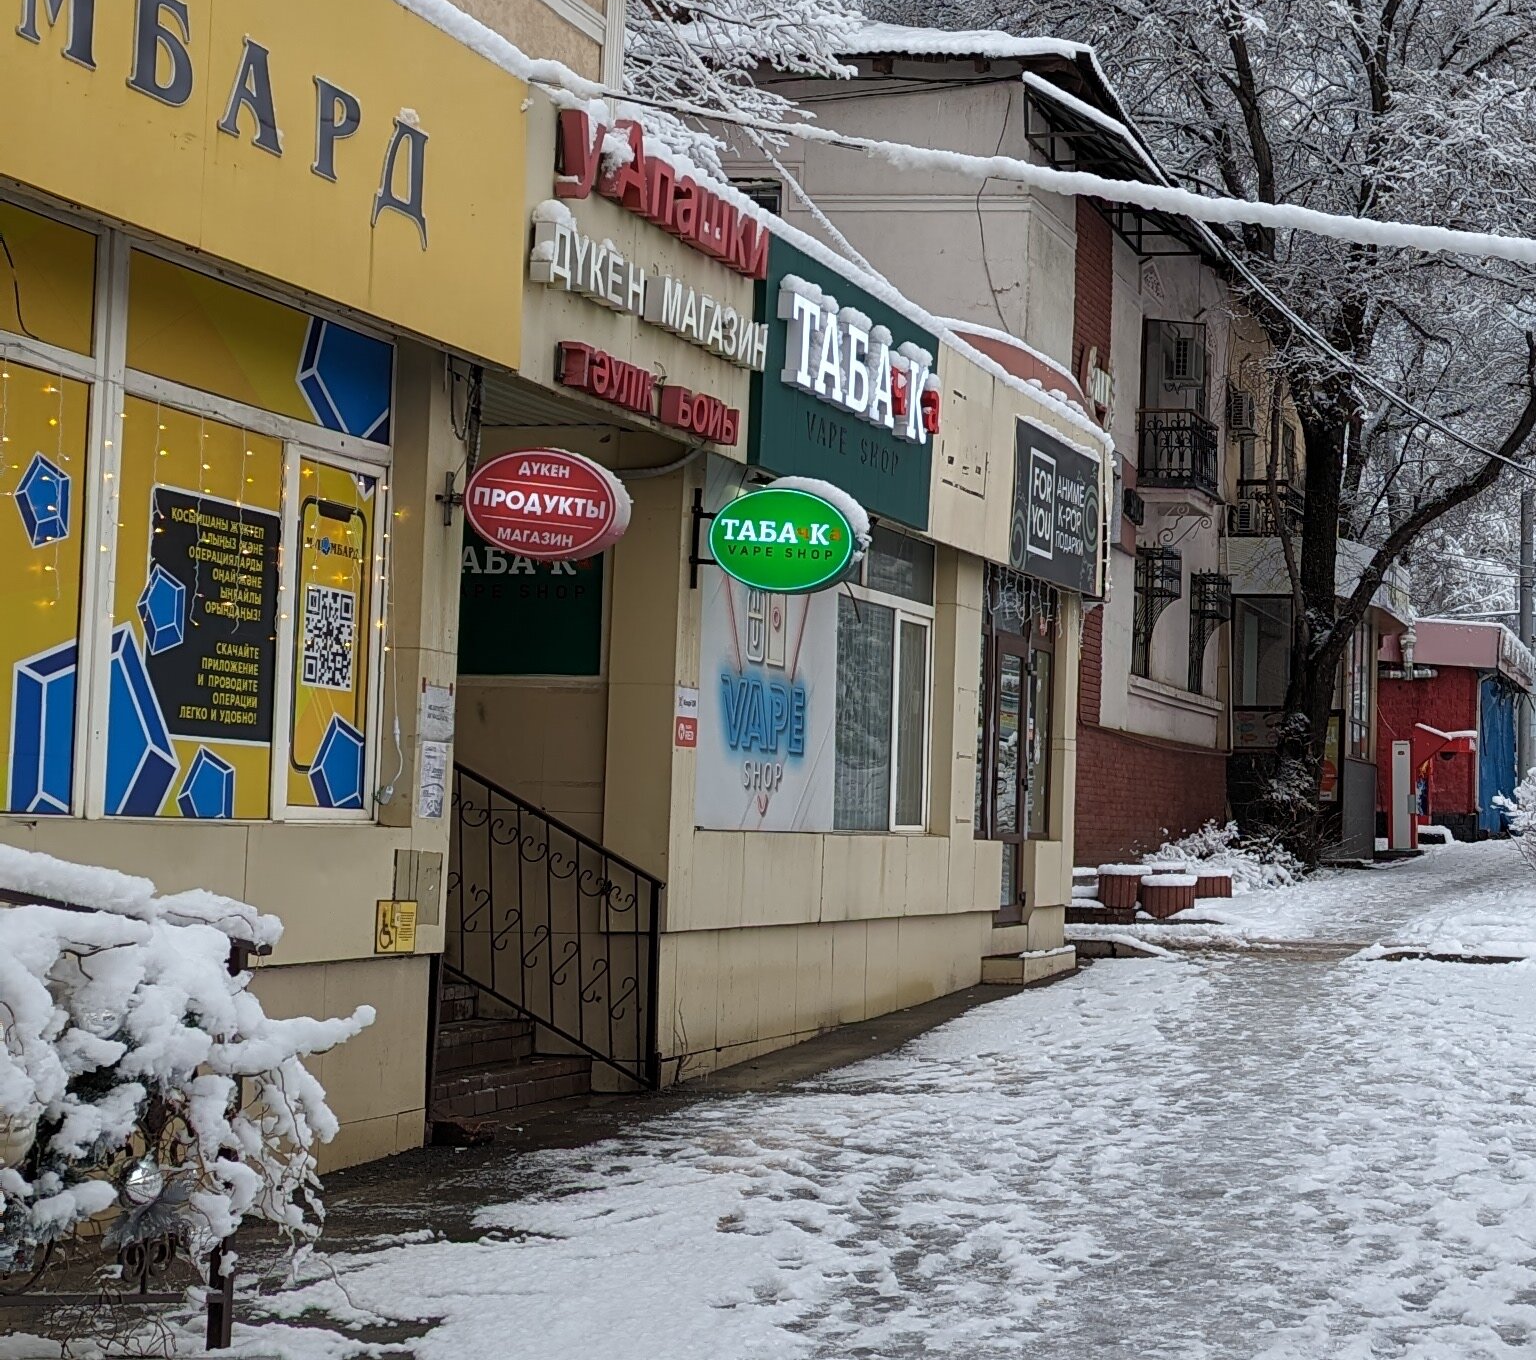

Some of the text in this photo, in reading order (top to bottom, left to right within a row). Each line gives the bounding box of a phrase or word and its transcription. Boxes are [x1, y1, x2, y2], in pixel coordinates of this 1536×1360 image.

[656, 274, 769, 373] МАГАЗИН
[665, 385, 740, 447] БОЙЫ
[806, 410, 900, 477] VAPE SHOP
[1033, 466, 1053, 504] FOR
[1056, 474, 1085, 508] АНИМЕ
[473, 486, 607, 520] ПРОДУКТЫ
[1057, 502, 1082, 535] K-POP
[497, 526, 574, 548] МАГАЗИН
[1031, 504, 1052, 541] YOU
[727, 544, 833, 561] VAPE SHOP
[1055, 530, 1084, 557] ПОДАРКИ
[201, 657, 259, 676] ПРИЛОЖЕНИЕ
[215, 642, 260, 660] СКАЧАЙТЕ
[197, 673, 258, 693] И ПРОВОДИТЕ
[179, 705, 257, 726] ЛЕГКО И УДОБНО!
[212, 692, 258, 710] ОПЕРАЦИИ
[720, 673, 806, 758] VAPE
[743, 759, 783, 791] SHOP
